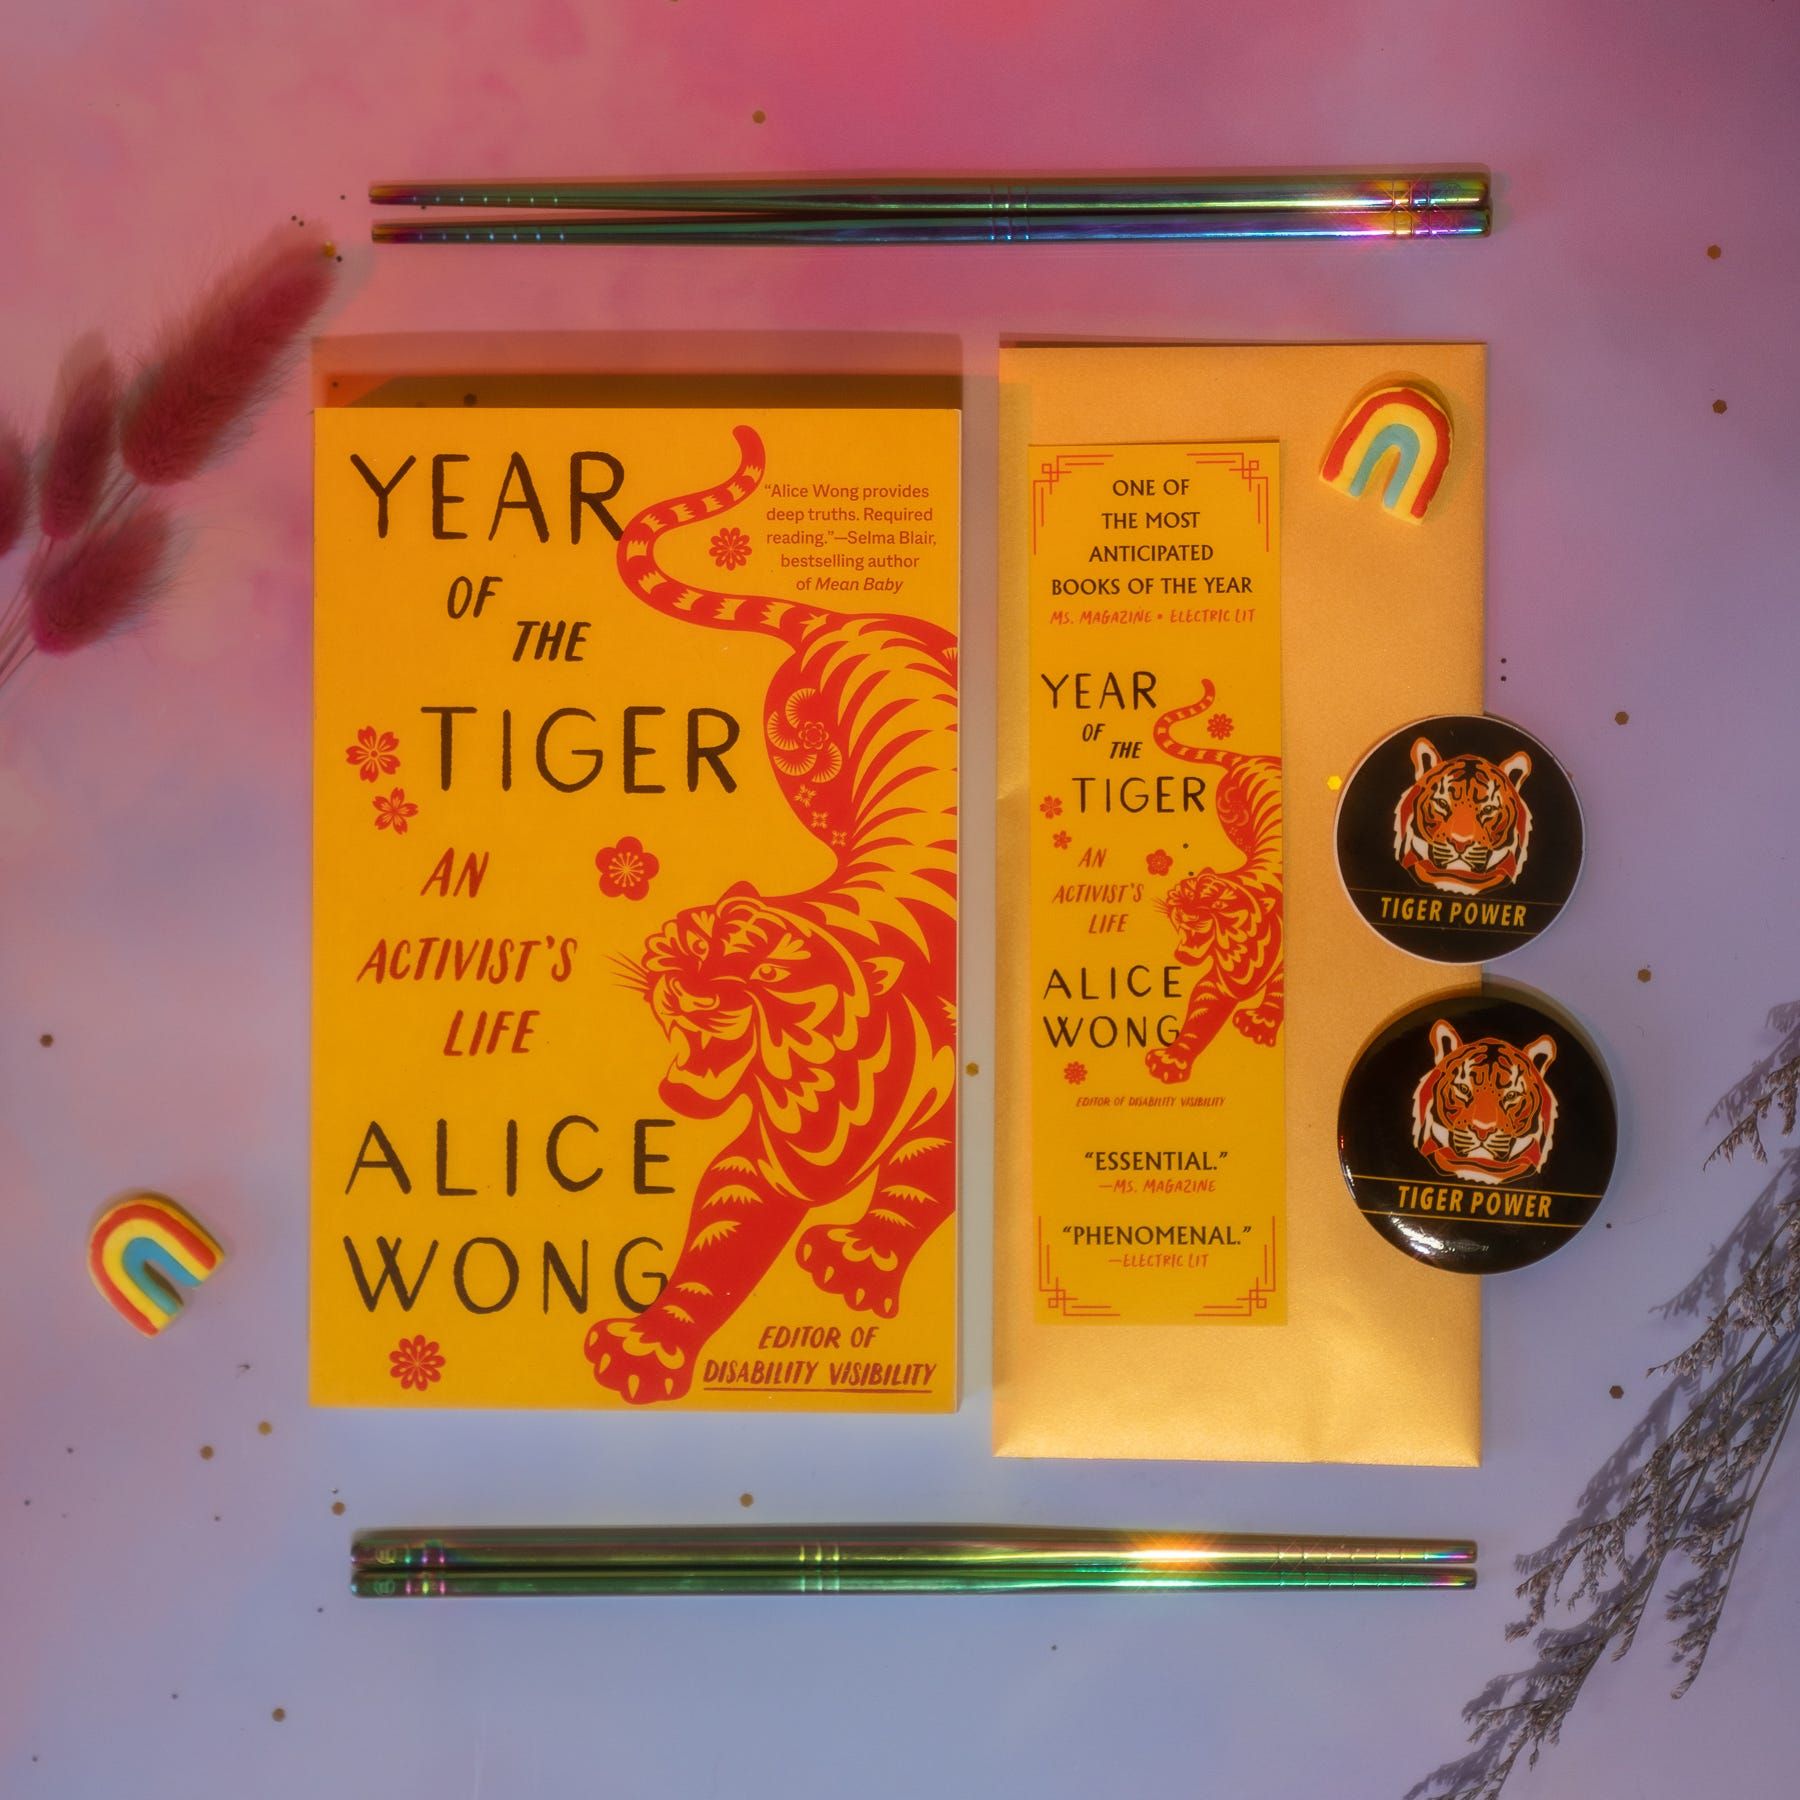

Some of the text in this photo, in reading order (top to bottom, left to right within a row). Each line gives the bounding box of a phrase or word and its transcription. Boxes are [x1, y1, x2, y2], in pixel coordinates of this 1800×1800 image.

[351, 451, 625, 543] YEAR
[813, 484, 859, 501] Wong
[863, 484, 929, 501] provides
[1112, 478, 1191, 497] ONE OF
[766, 508, 933, 524] deep truths. Required
[1101, 511, 1201, 529] THE MOST
[900, 531, 937, 547] Blair,
[781, 554, 920, 571] bestselling author
[1088, 544, 1214, 562] ANTICIPATED
[796, 577, 904, 594] of Mean Baby
[1051, 577, 1253, 596] BOOKS OF THE YEAR
[447, 575, 502, 619] OF
[1079, 609, 1152, 625] MAGAZINE
[1170, 608, 1230, 624] ELECTRIC
[1235, 608, 1256, 623] LIT
[512, 620, 591, 662] THE
[1040, 671, 1157, 710] YEAR
[1082, 723, 1105, 742] OF
[421, 706, 740, 793] TIGER
[1109, 741, 1143, 759] THE
[1072, 776, 1206, 813] TIGER
[1078, 847, 1107, 868] AN
[421, 847, 489, 898] AN
[1052, 883, 1144, 904] ACTIVIST'S
[1381, 897, 1527, 927] TIGER POWER
[1088, 913, 1129, 934] LIFE
[356, 937, 577, 984] ACTIVIST'S
[1043, 965, 1182, 1000] ALICE
[444, 1010, 540, 1056] LIFE
[1043, 1014, 1181, 1049] WONG
[1076, 1096, 1226, 1107] EDITOR OF DISABILITY VISIBILITY
[346, 1115, 676, 1197] ALICE
[1143, 1179, 1216, 1193] MAGAZINE
[1399, 1186, 1552, 1218] TIGER POWER
[1188, 1254, 1209, 1268] LIT
[343, 1235, 668, 1315] WONG
[758, 1326, 879, 1349] EDITOR OF
[703, 1359, 937, 1386] DISABILITY VISIBILITY
